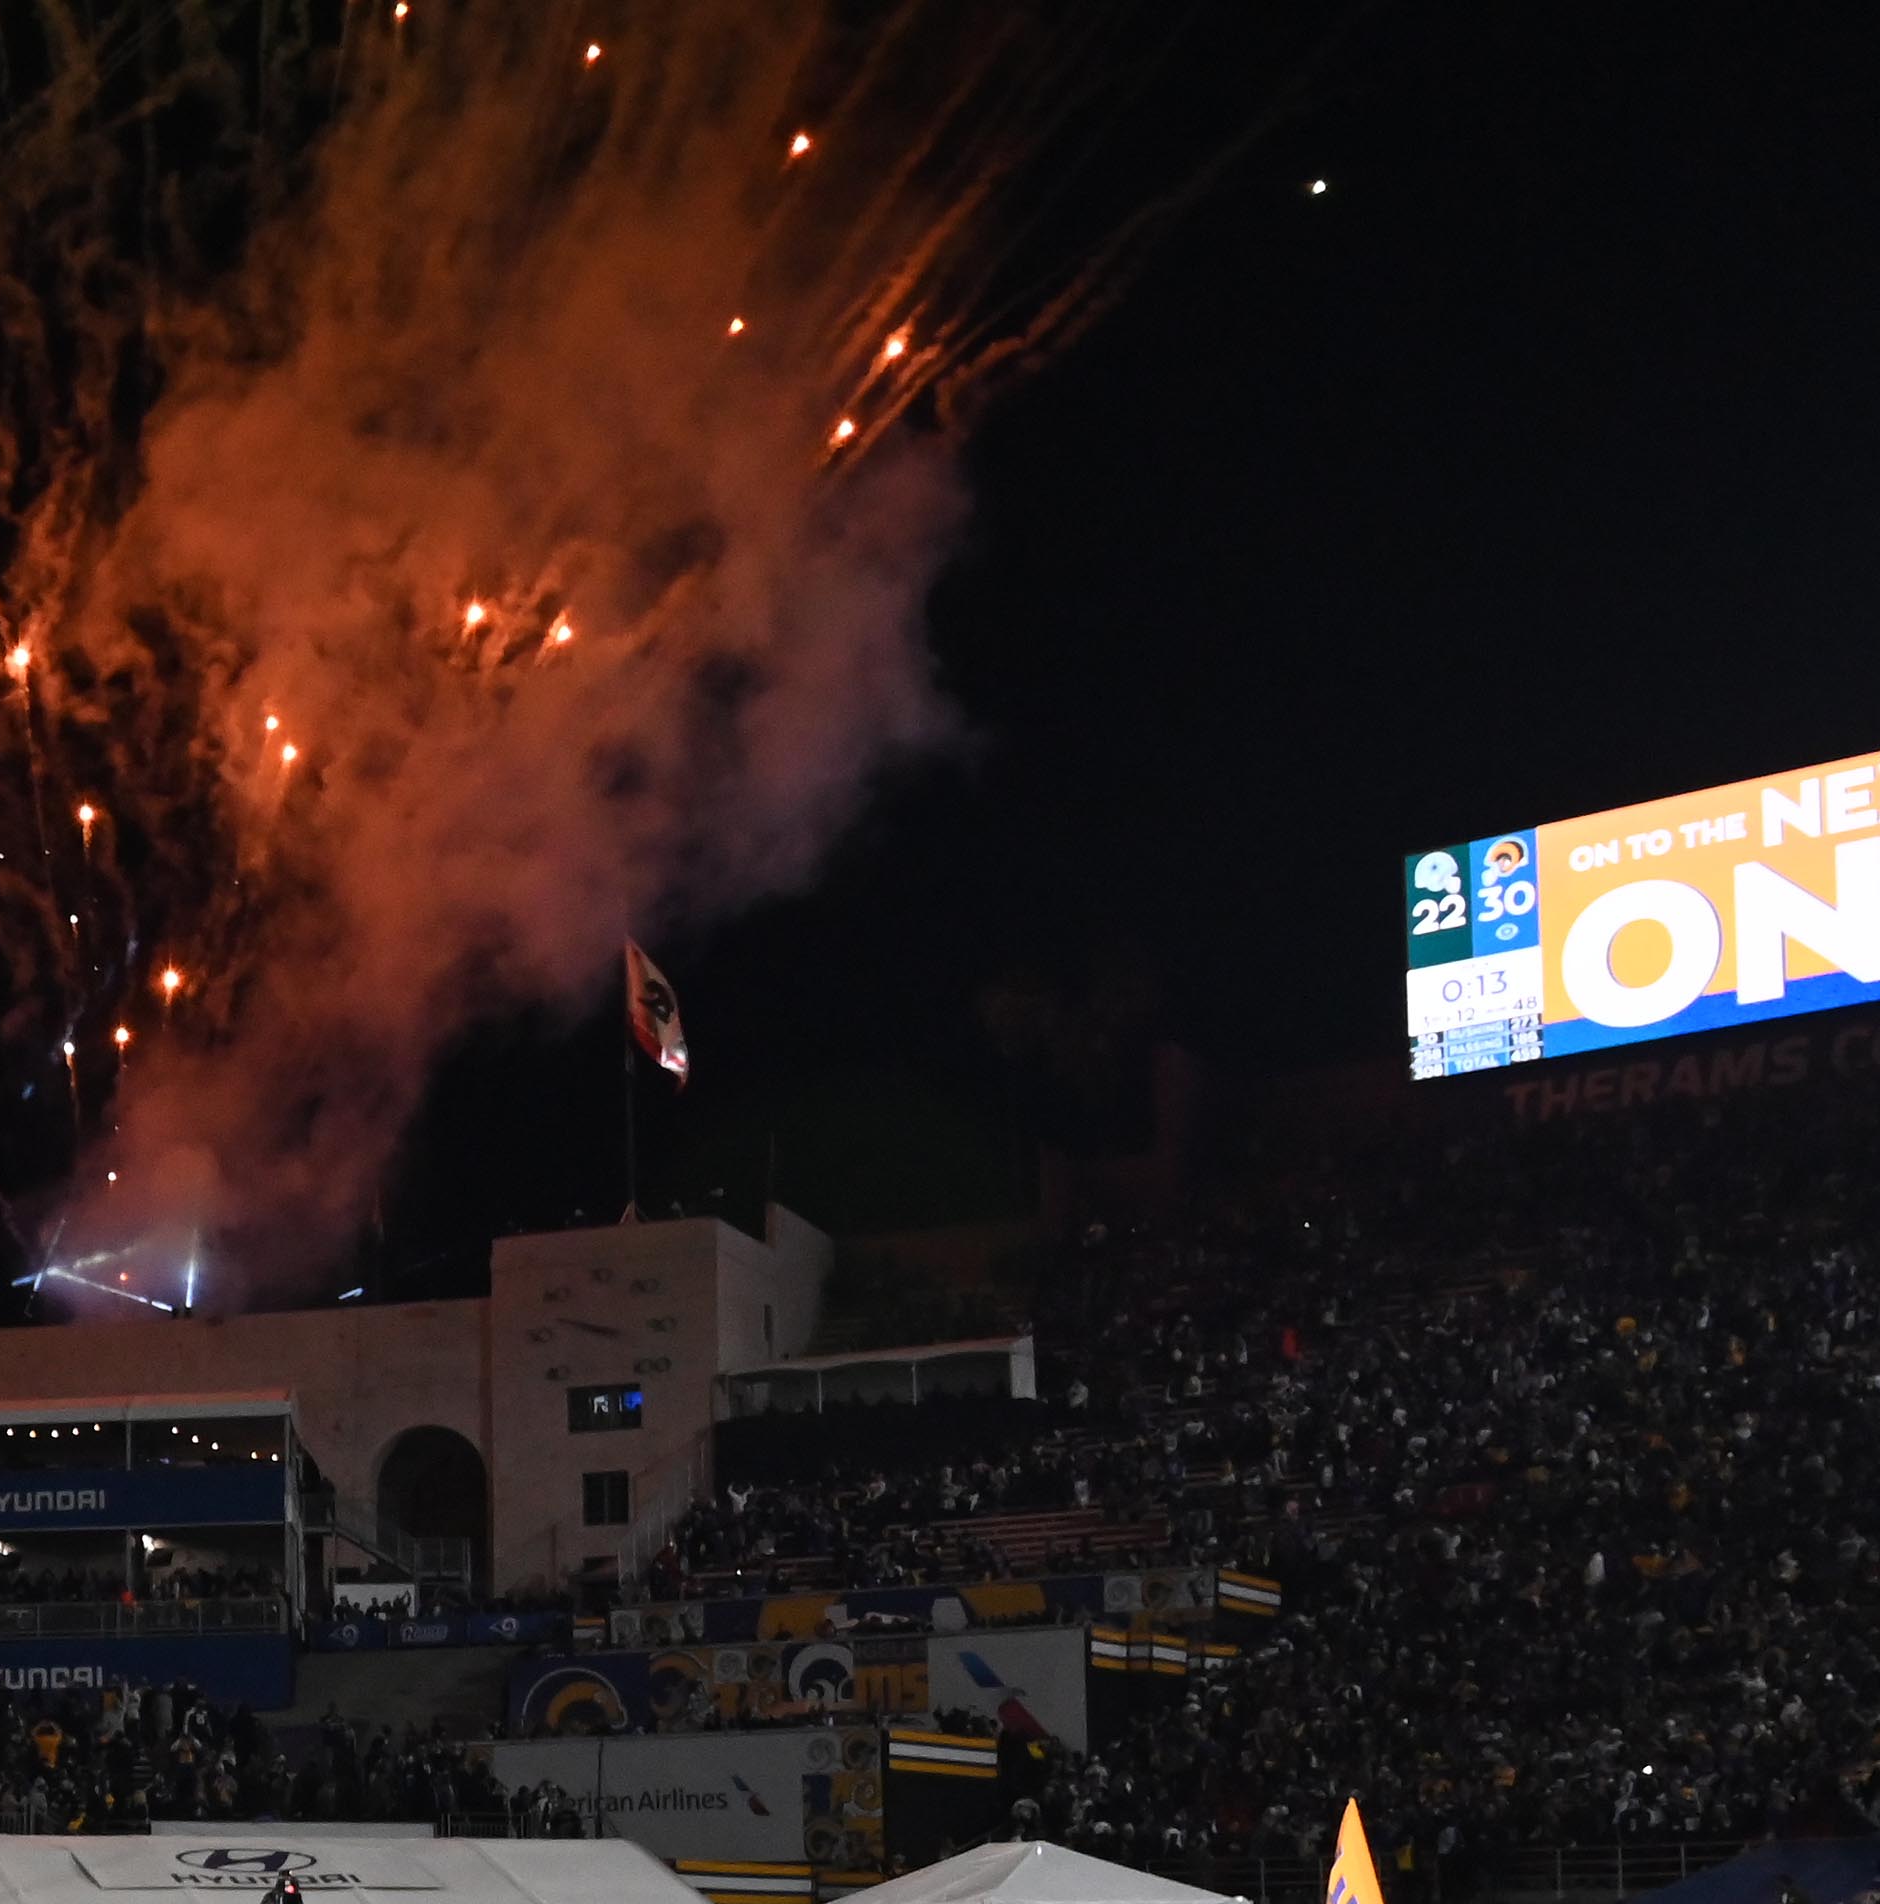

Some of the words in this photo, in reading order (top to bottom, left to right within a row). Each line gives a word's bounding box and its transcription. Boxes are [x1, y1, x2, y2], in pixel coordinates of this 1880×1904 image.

[1568, 838, 1620, 872] ON
[1625, 828, 1673, 860] TO
[1679, 812, 1748, 849] THE
[1761, 765, 1880, 848] NE
[1412, 893, 1467, 936] 22
[1477, 880, 1536, 922] 30
[1442, 969, 1508, 1003] 0:13
[1453, 1052, 1500, 1072] TOTAL
[638, 1787, 729, 1811] Airlines
